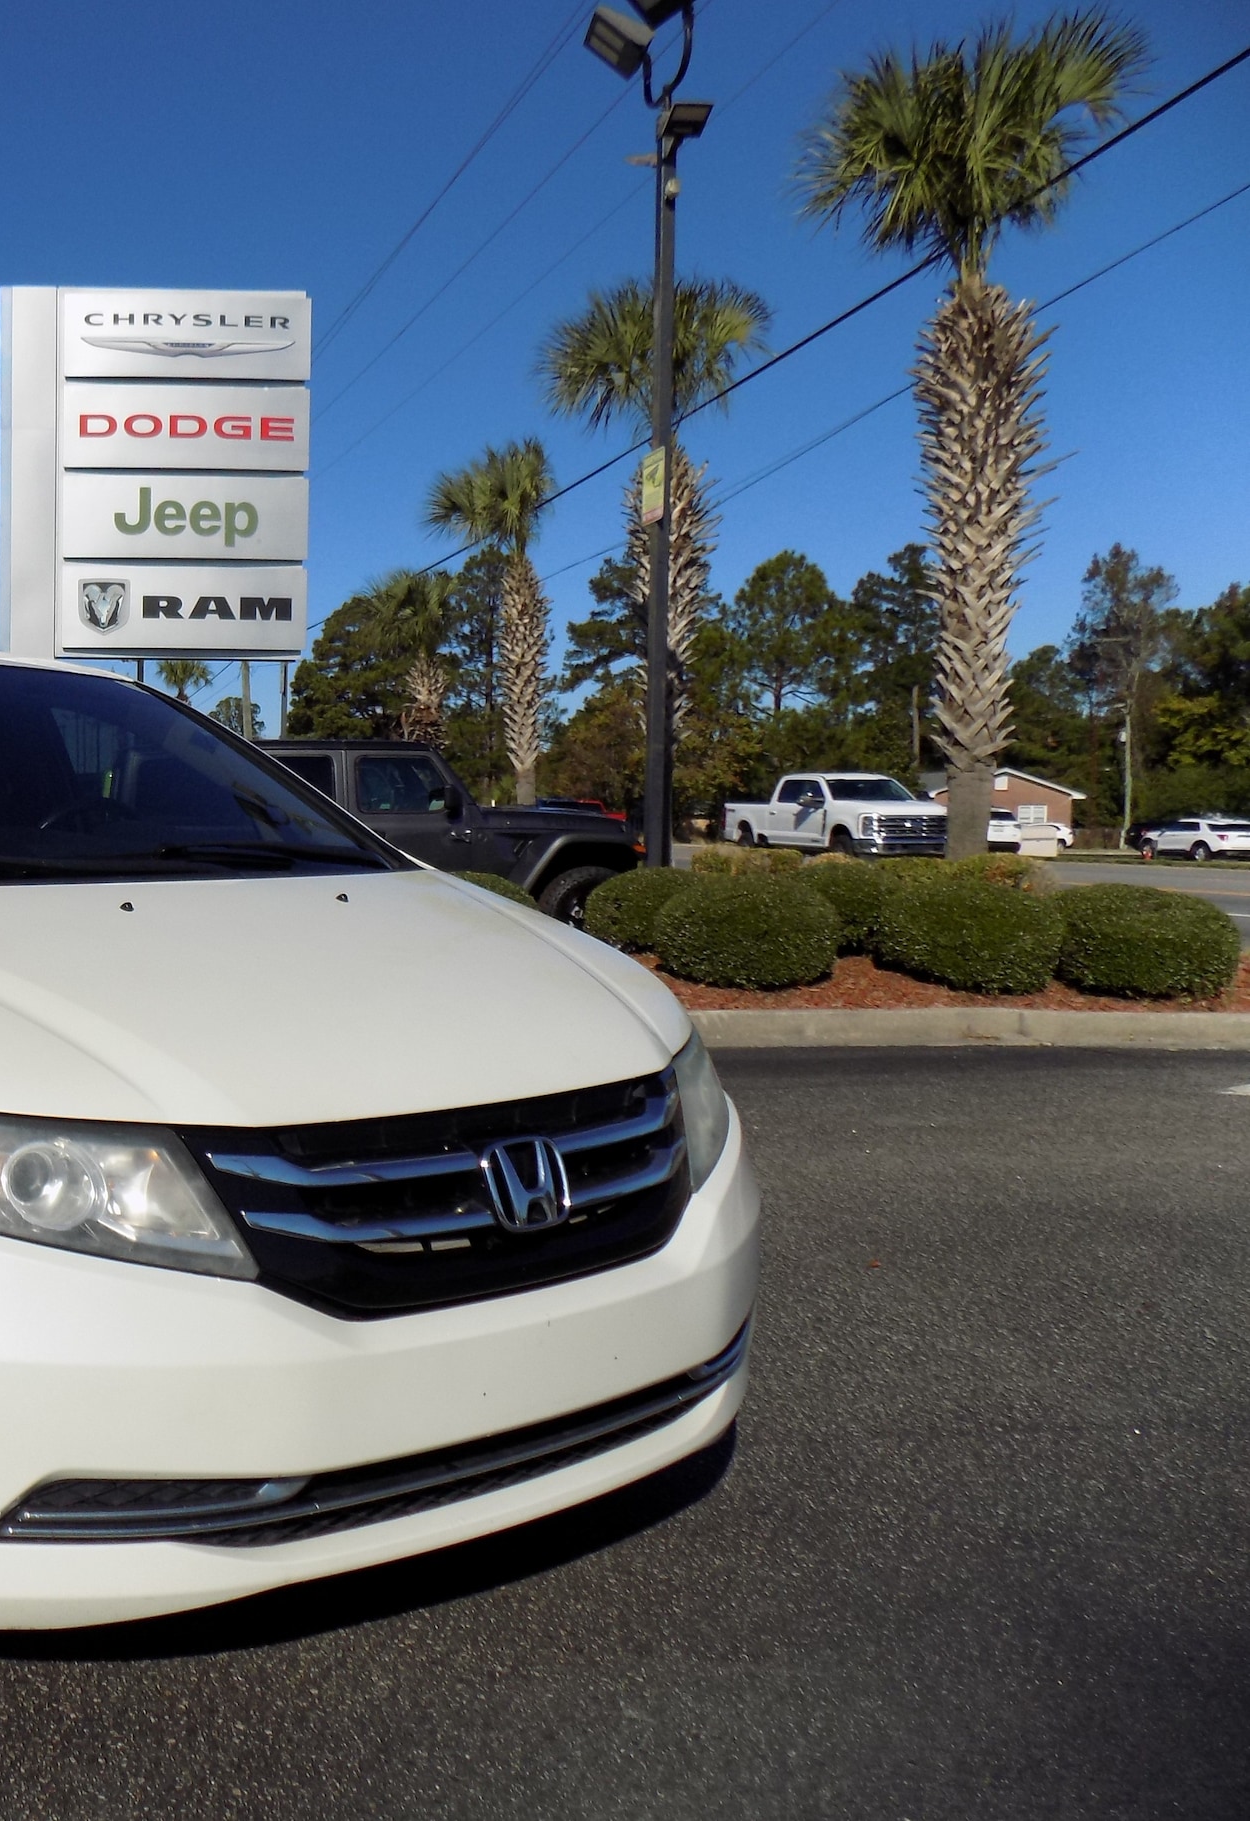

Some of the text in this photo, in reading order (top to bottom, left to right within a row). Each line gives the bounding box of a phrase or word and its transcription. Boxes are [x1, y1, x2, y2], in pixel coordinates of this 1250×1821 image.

[84, 313, 291, 330] CHRYSLER
[79, 414, 295, 442] DODGE
[114, 487, 259, 546] Jeep
[142, 595, 293, 621] RAM
